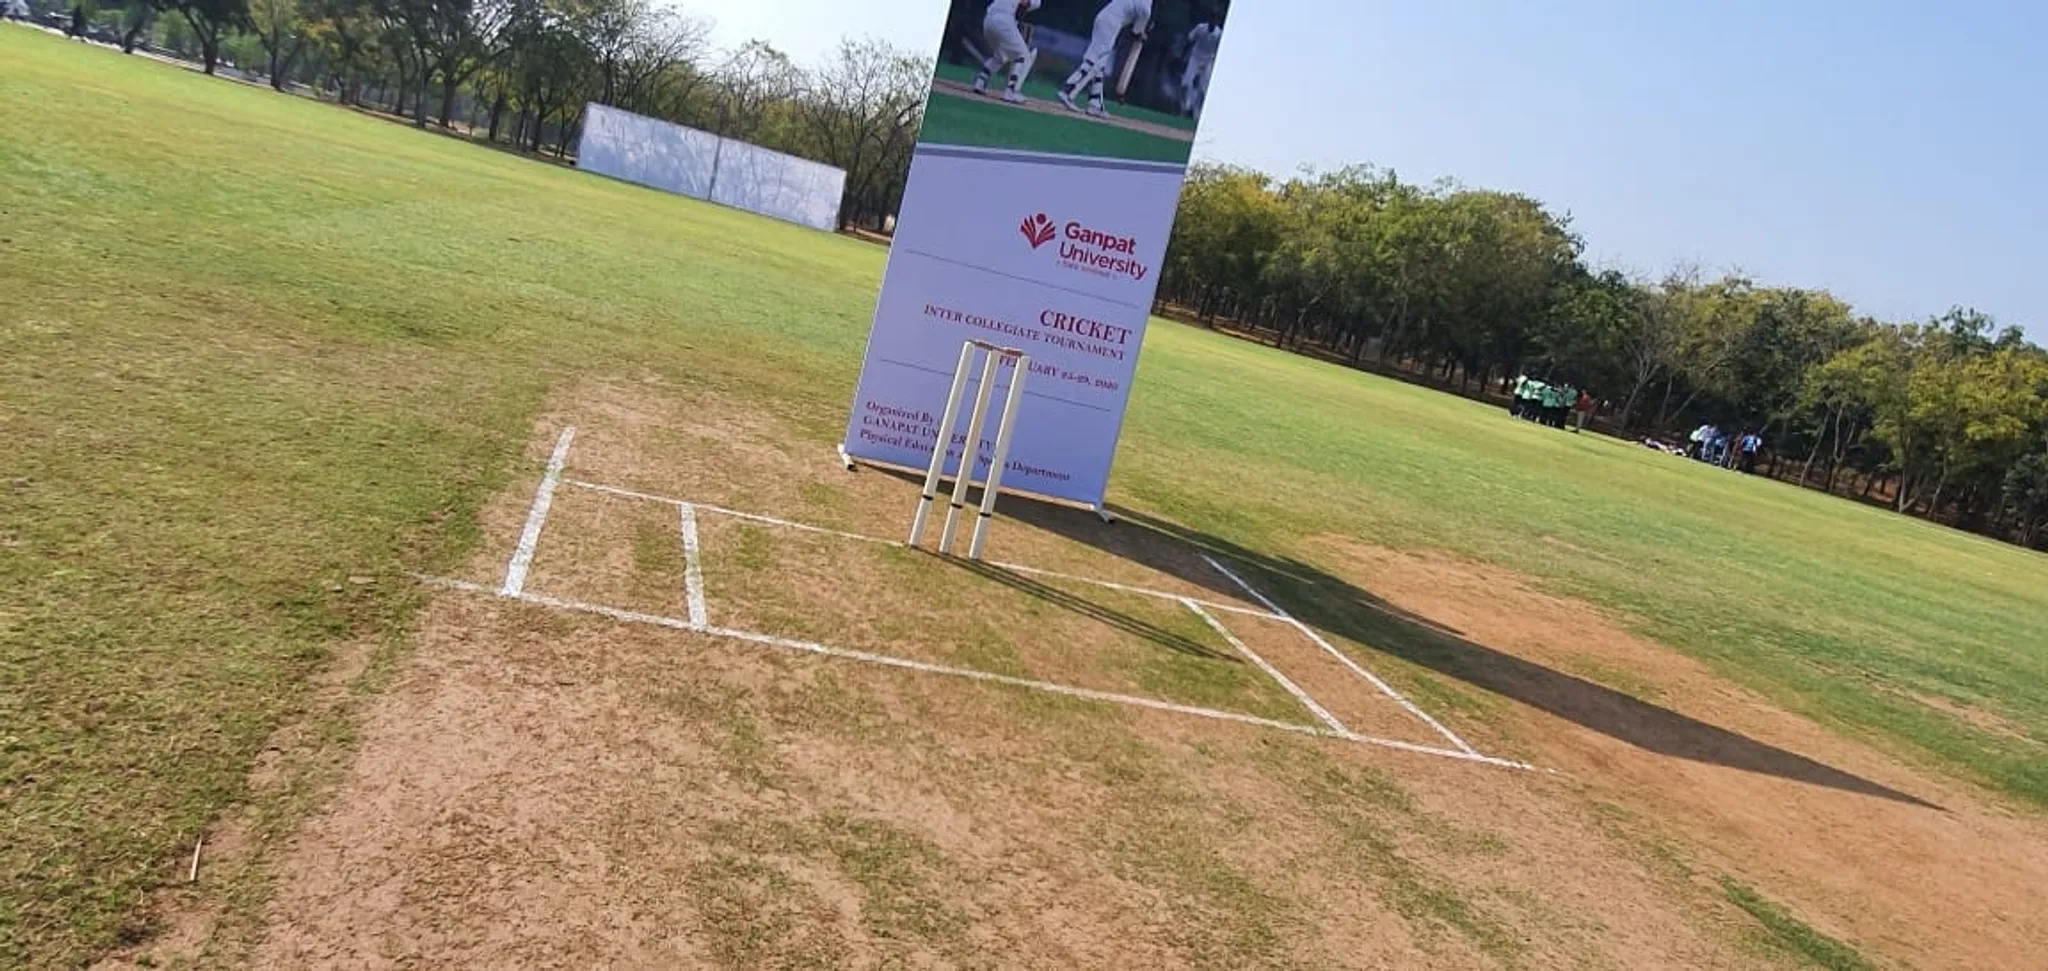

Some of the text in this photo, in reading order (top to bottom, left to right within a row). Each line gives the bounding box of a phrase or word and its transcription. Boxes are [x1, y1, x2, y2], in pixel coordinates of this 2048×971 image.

[1065, 222, 1136, 255] Ganpat
[1060, 241, 1147, 280] University
[925, 304, 1124, 360] INTER COLLEGIATE TOURNAMENT
[1040, 310, 1132, 344] CRICKET
[999, 354, 1060, 377] FEBUARY
[866, 401, 919, 420] Organized
[863, 415, 994, 450] GANAPAT UNERTY
